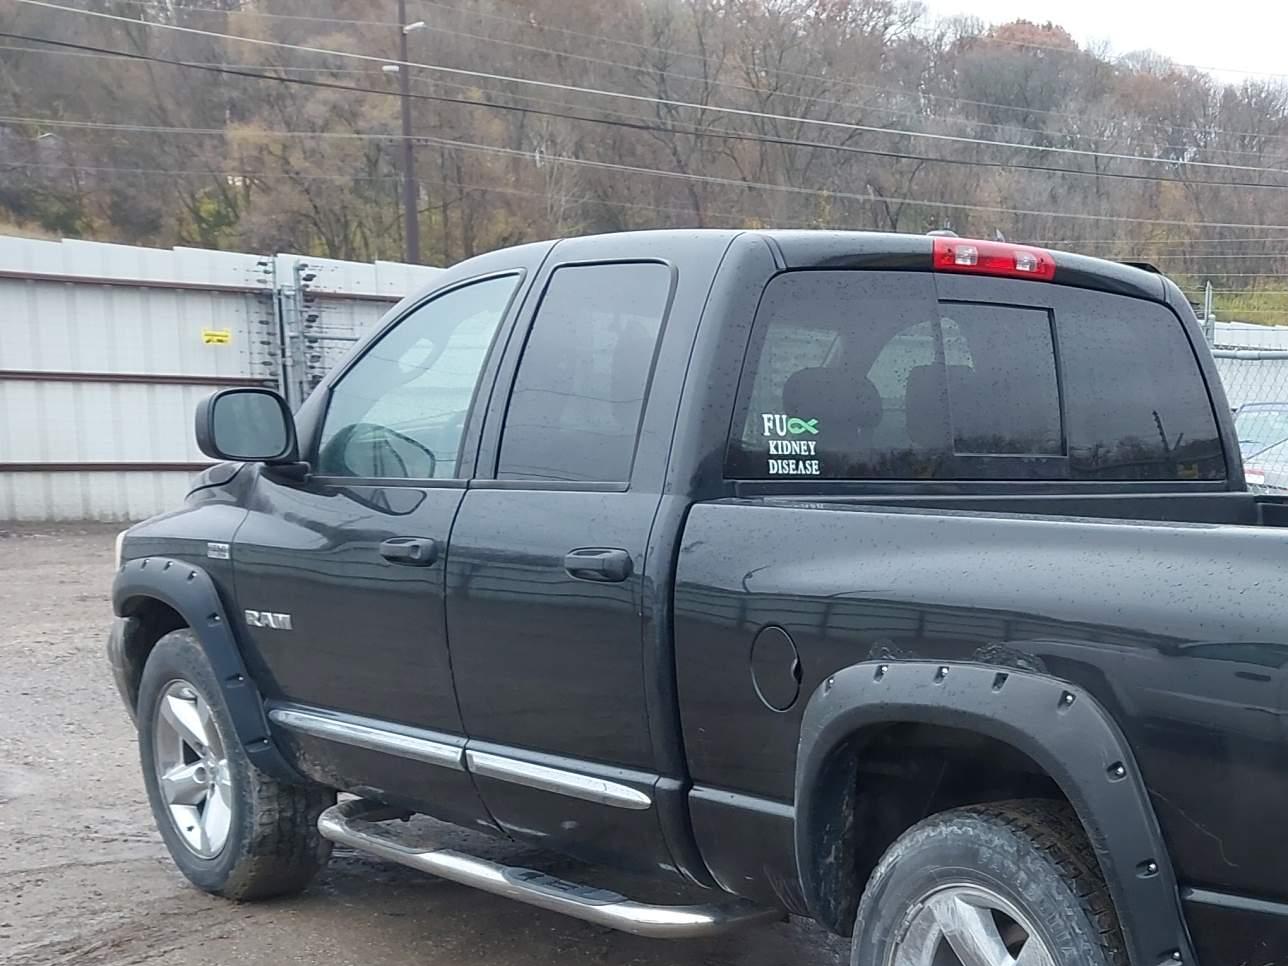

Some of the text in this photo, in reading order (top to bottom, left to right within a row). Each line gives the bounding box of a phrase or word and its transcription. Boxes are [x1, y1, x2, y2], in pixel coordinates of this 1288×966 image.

[768, 440, 817, 455] KIDNEY
[768, 459, 821, 475] DISEASE
[245, 609, 292, 630] RAM
